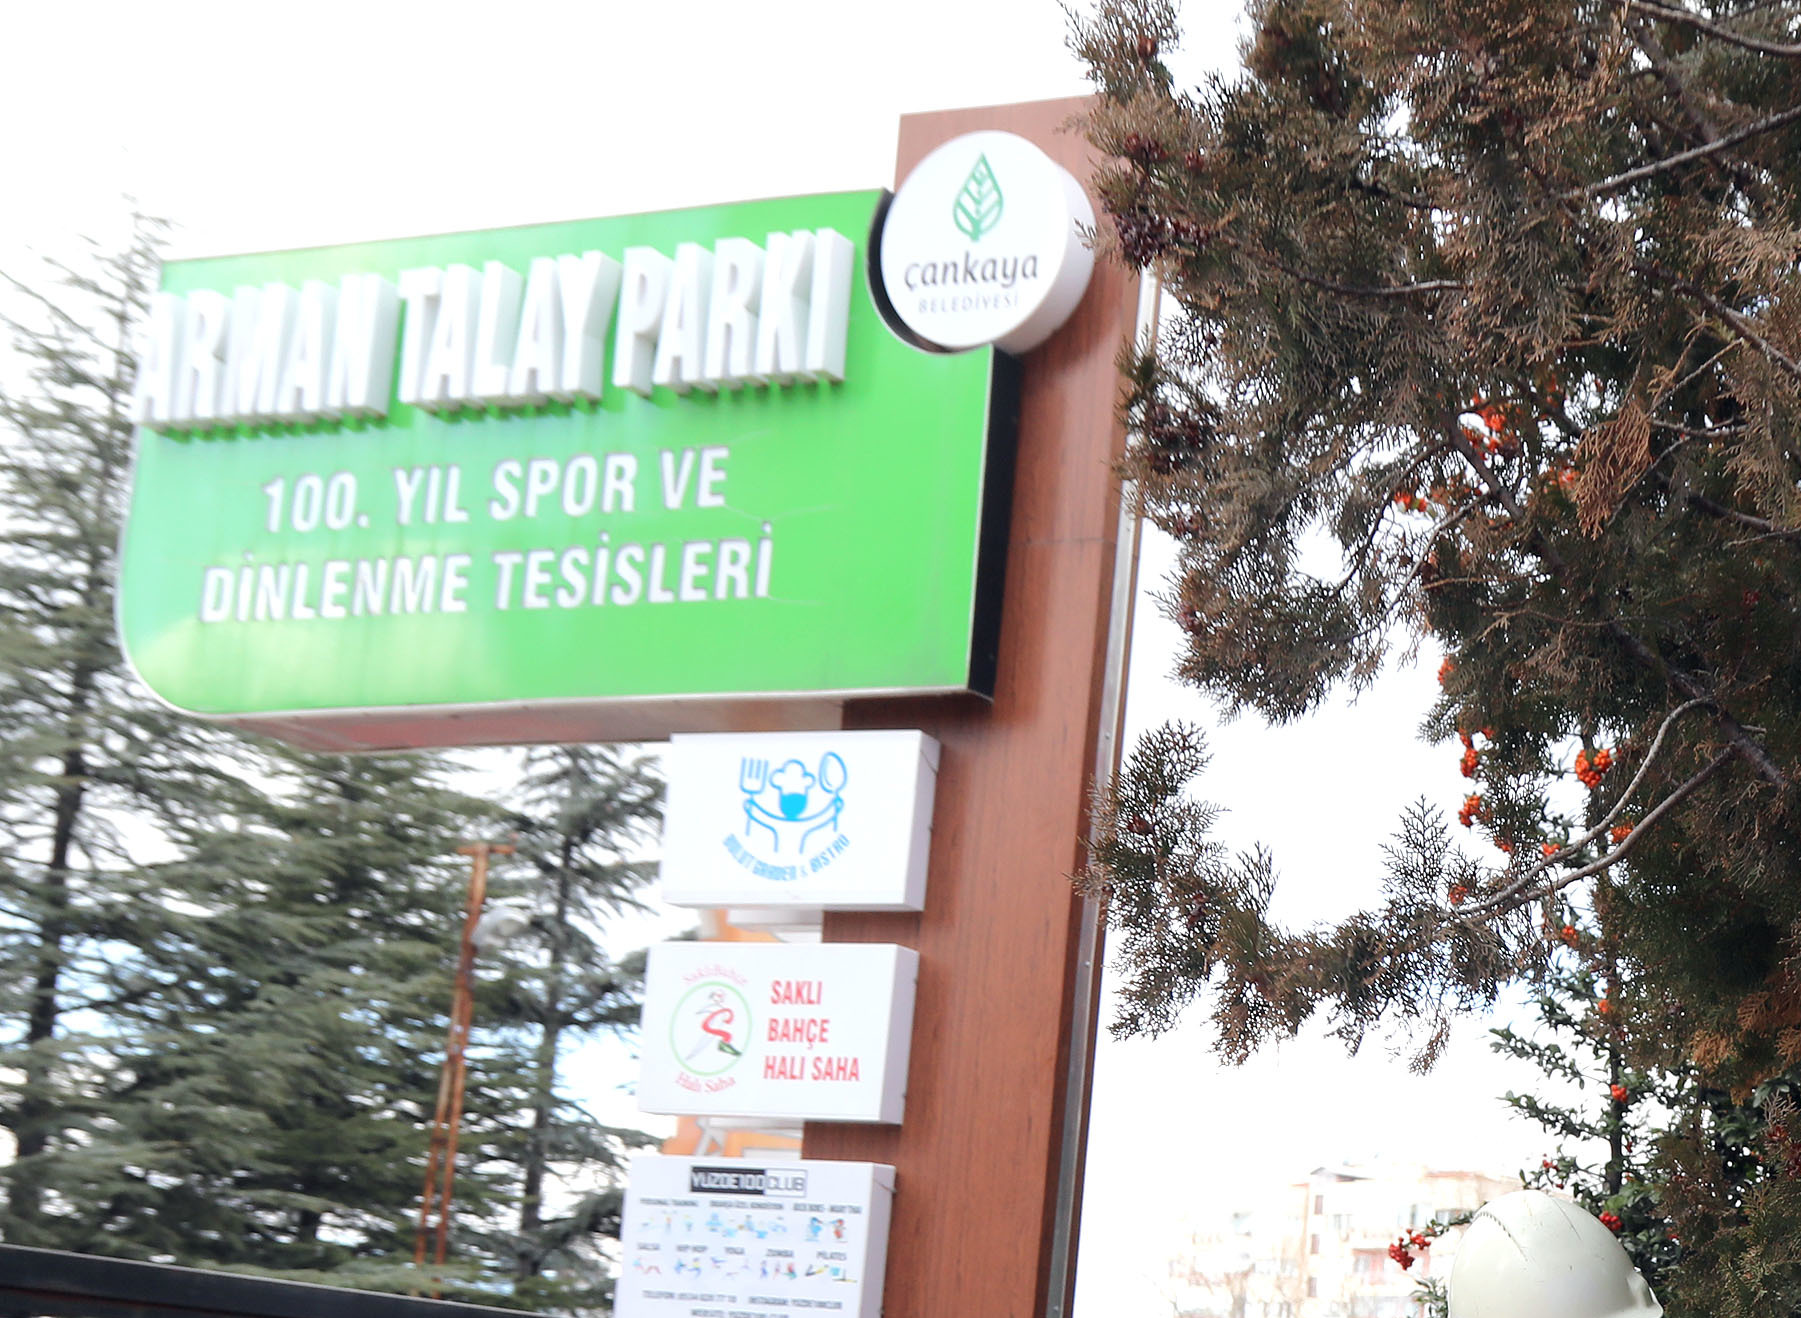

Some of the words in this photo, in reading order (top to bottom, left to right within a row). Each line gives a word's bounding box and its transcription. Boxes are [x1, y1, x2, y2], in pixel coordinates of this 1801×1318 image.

[132, 273, 398, 422] ARMAN
[397, 251, 622, 414] TALAY
[612, 228, 854, 398] PARKI
[262, 475, 370, 534] 100.
[392, 463, 469, 526] YIL
[488, 451, 638, 521] SPOR
[659, 444, 730, 511] VE
[199, 549, 472, 624] DİNLENME
[492, 520, 773, 611] TESİSLERİ
[770, 980, 822, 1005] SAKLI
[767, 1018, 830, 1050] BAHÇE
[763, 1056, 805, 1080] HALI
[811, 1057, 860, 1081] SAHA
